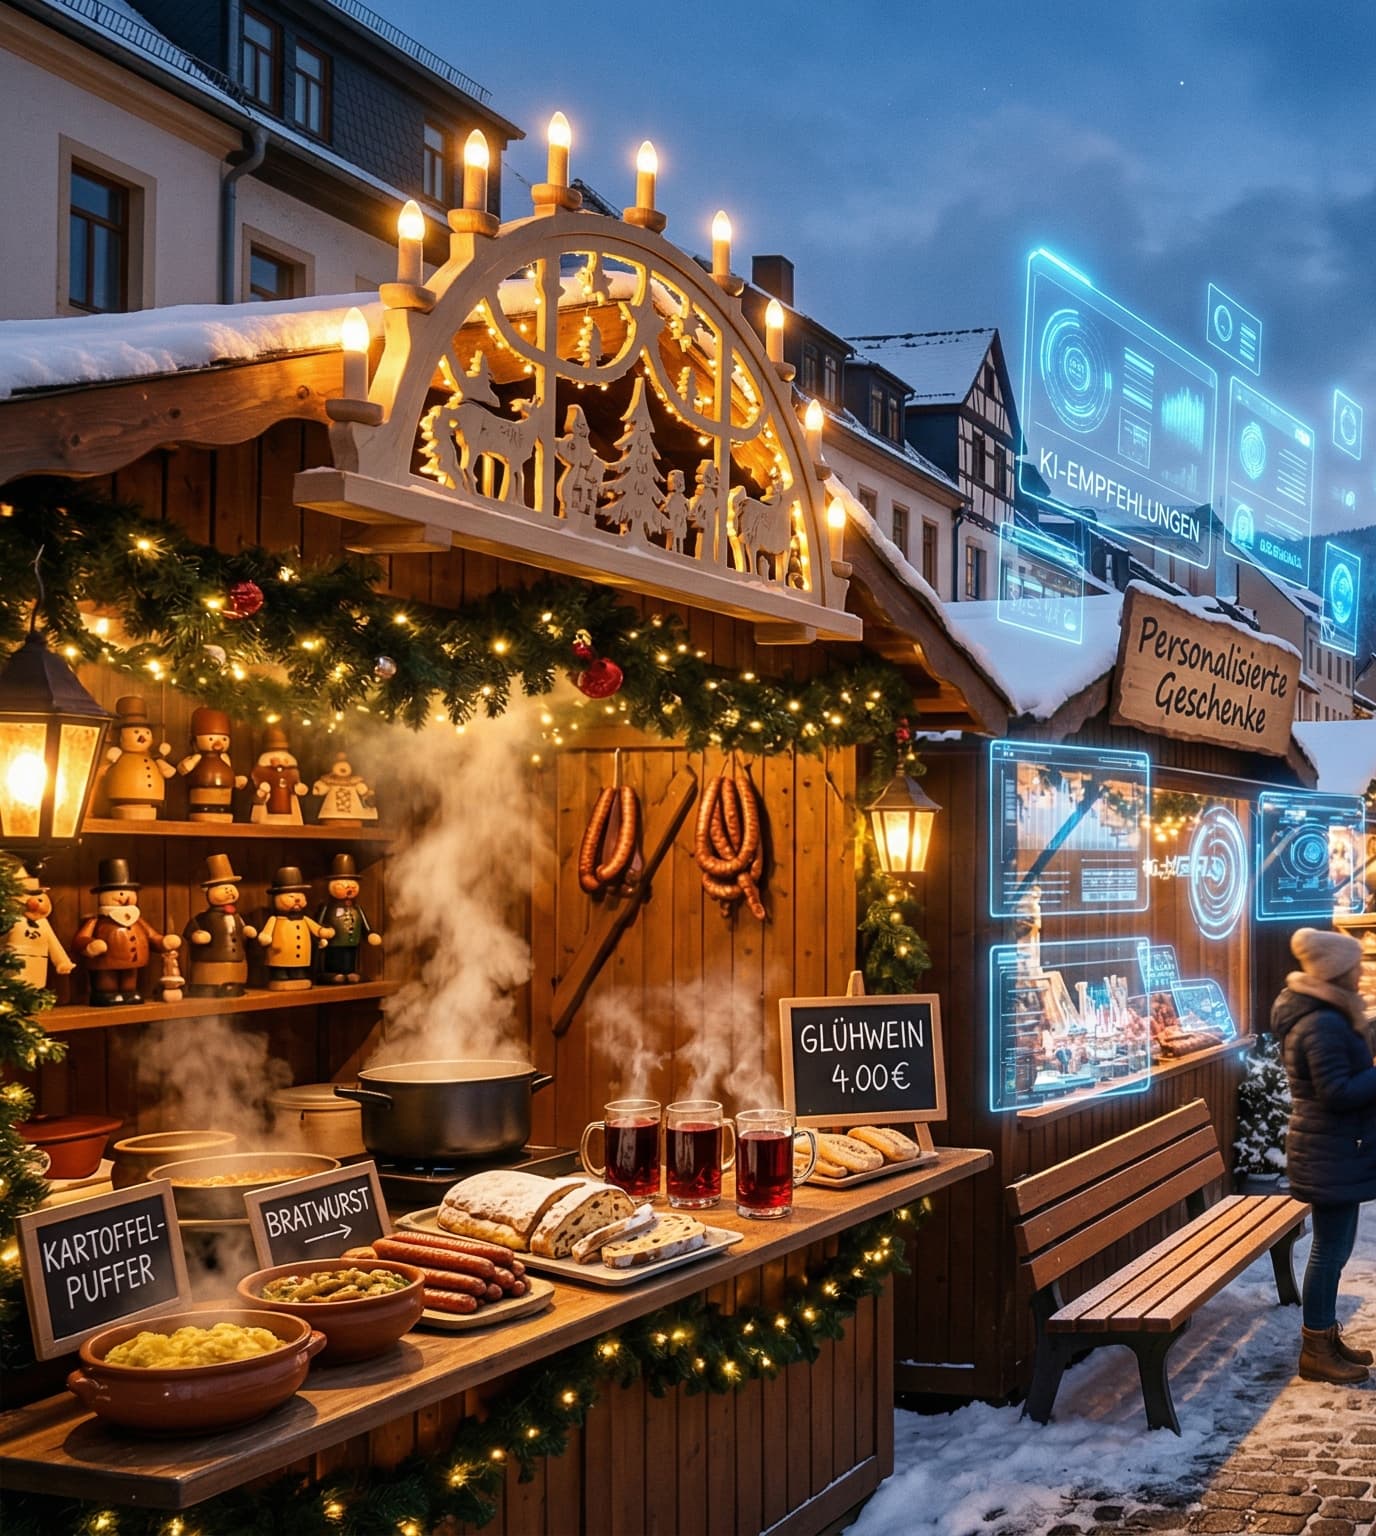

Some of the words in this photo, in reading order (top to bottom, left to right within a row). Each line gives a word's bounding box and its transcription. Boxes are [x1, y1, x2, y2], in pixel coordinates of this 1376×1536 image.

[1040, 447, 1200, 543] KI-EMPFEHLUNGEN
[1138, 616, 1288, 698] Personalisierte
[1155, 671, 1266, 734] Geschenke
[801, 1017, 924, 1053] GLÜHWEIN
[831, 1061, 911, 1093] 4.00€
[266, 1186, 371, 1238] BRATWURST
[43, 1214, 166, 1272] KARTOFFEL-
[67, 1254, 155, 1309] PUFFER
